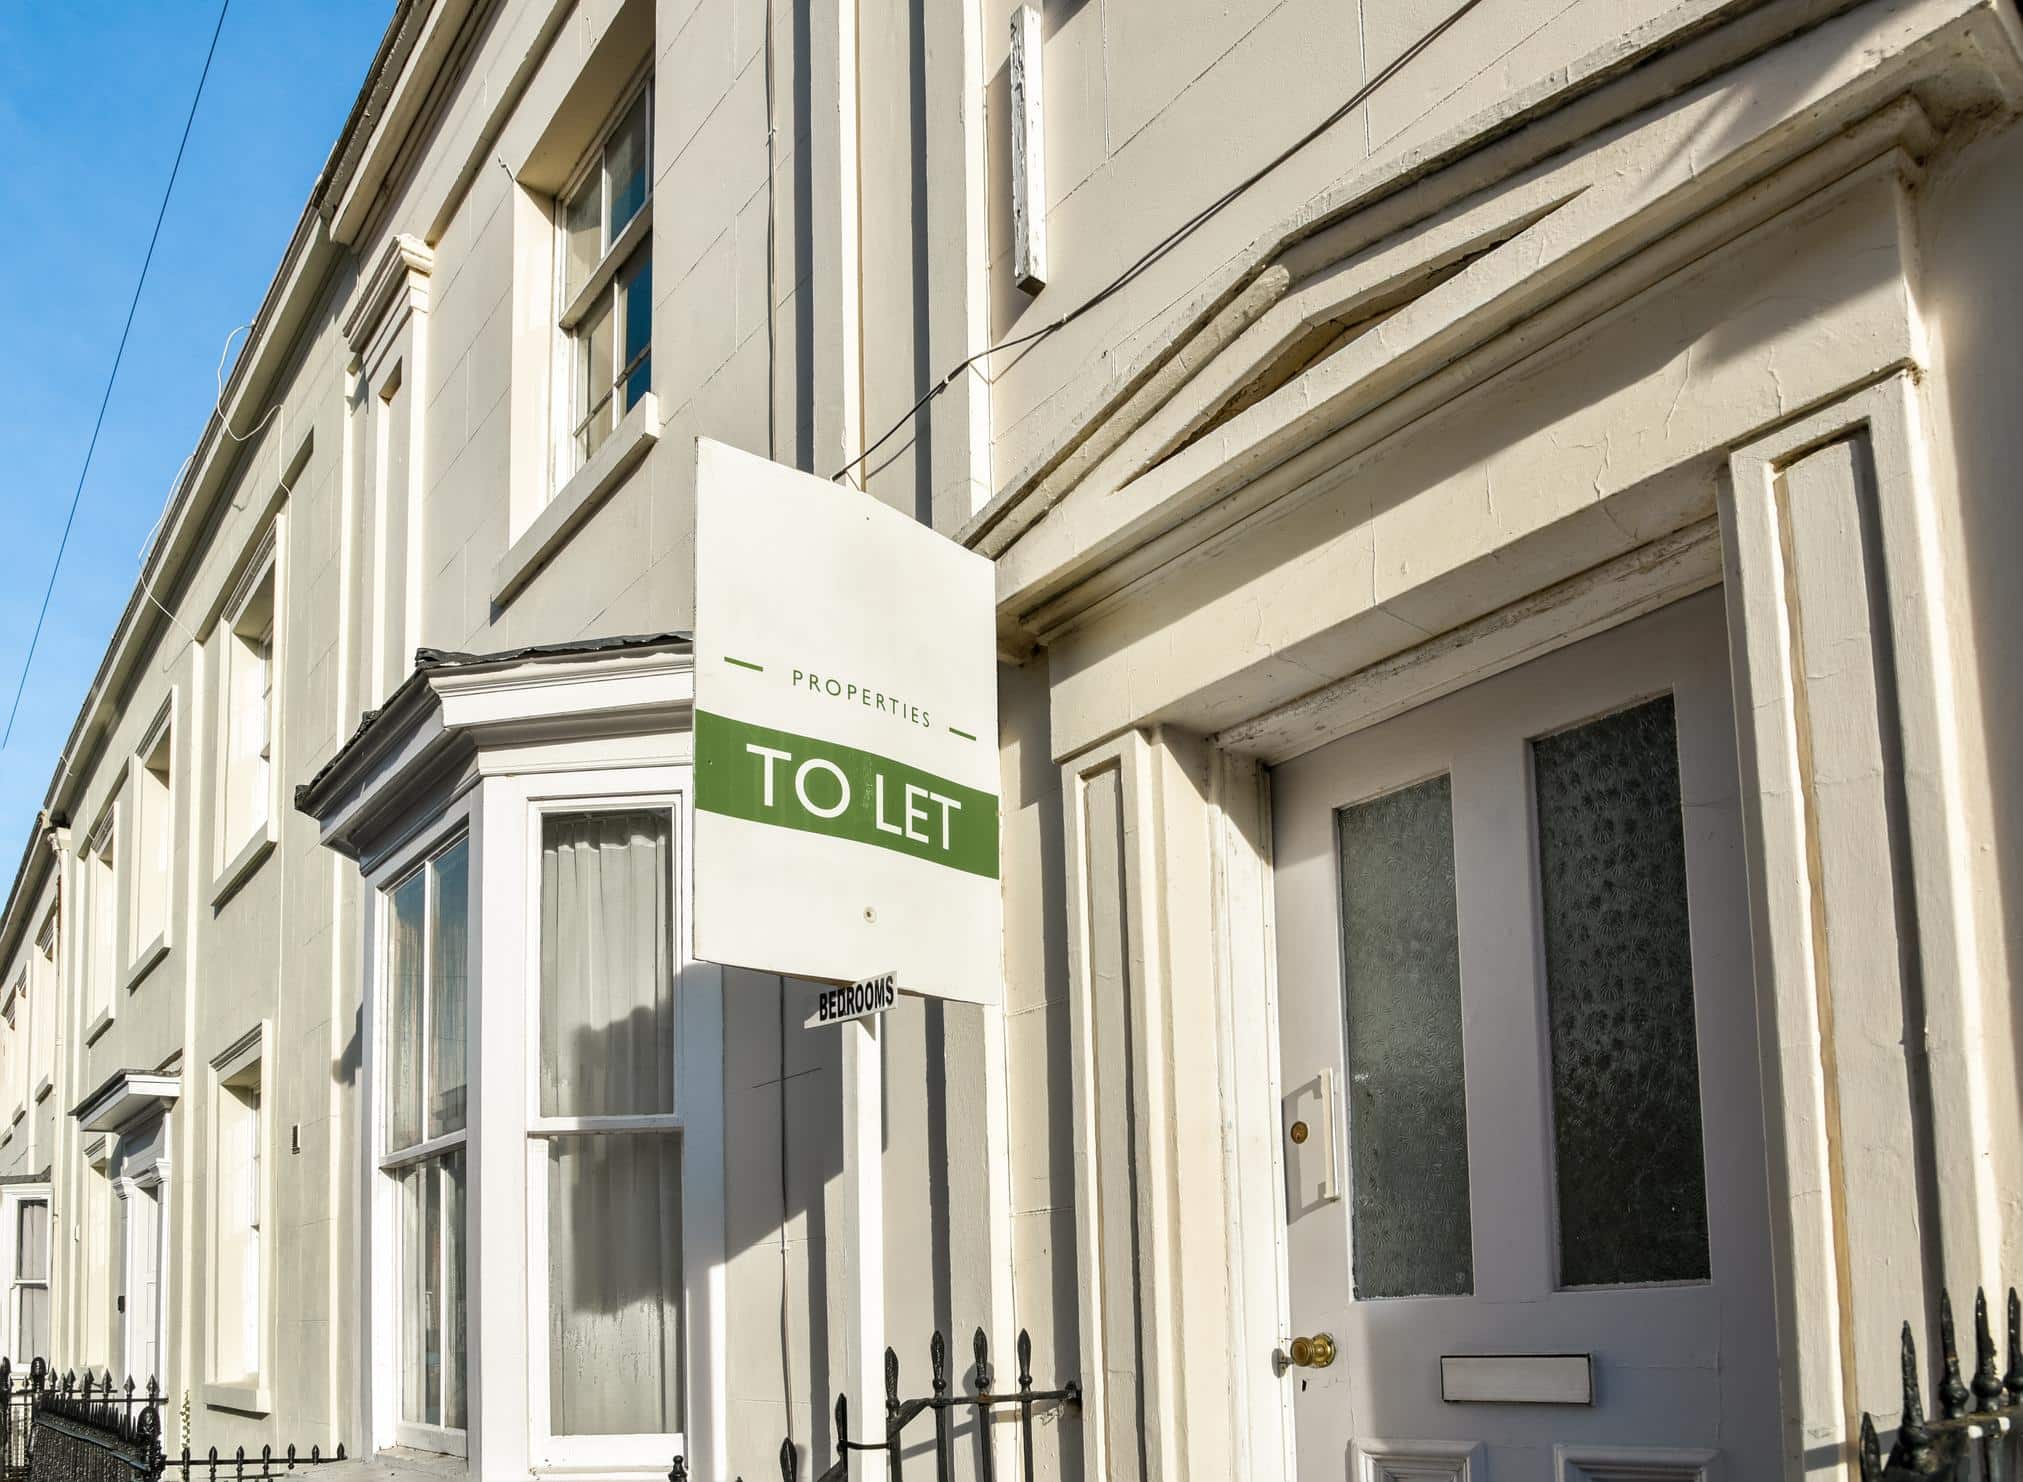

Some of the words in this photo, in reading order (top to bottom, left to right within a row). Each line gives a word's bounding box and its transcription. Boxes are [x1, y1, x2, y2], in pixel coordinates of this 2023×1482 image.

[792, 669, 931, 729] PROPERTIES
[745, 743, 851, 818] TO
[876, 774, 962, 850] LET
[819, 975, 895, 1022] BEDROOMS
